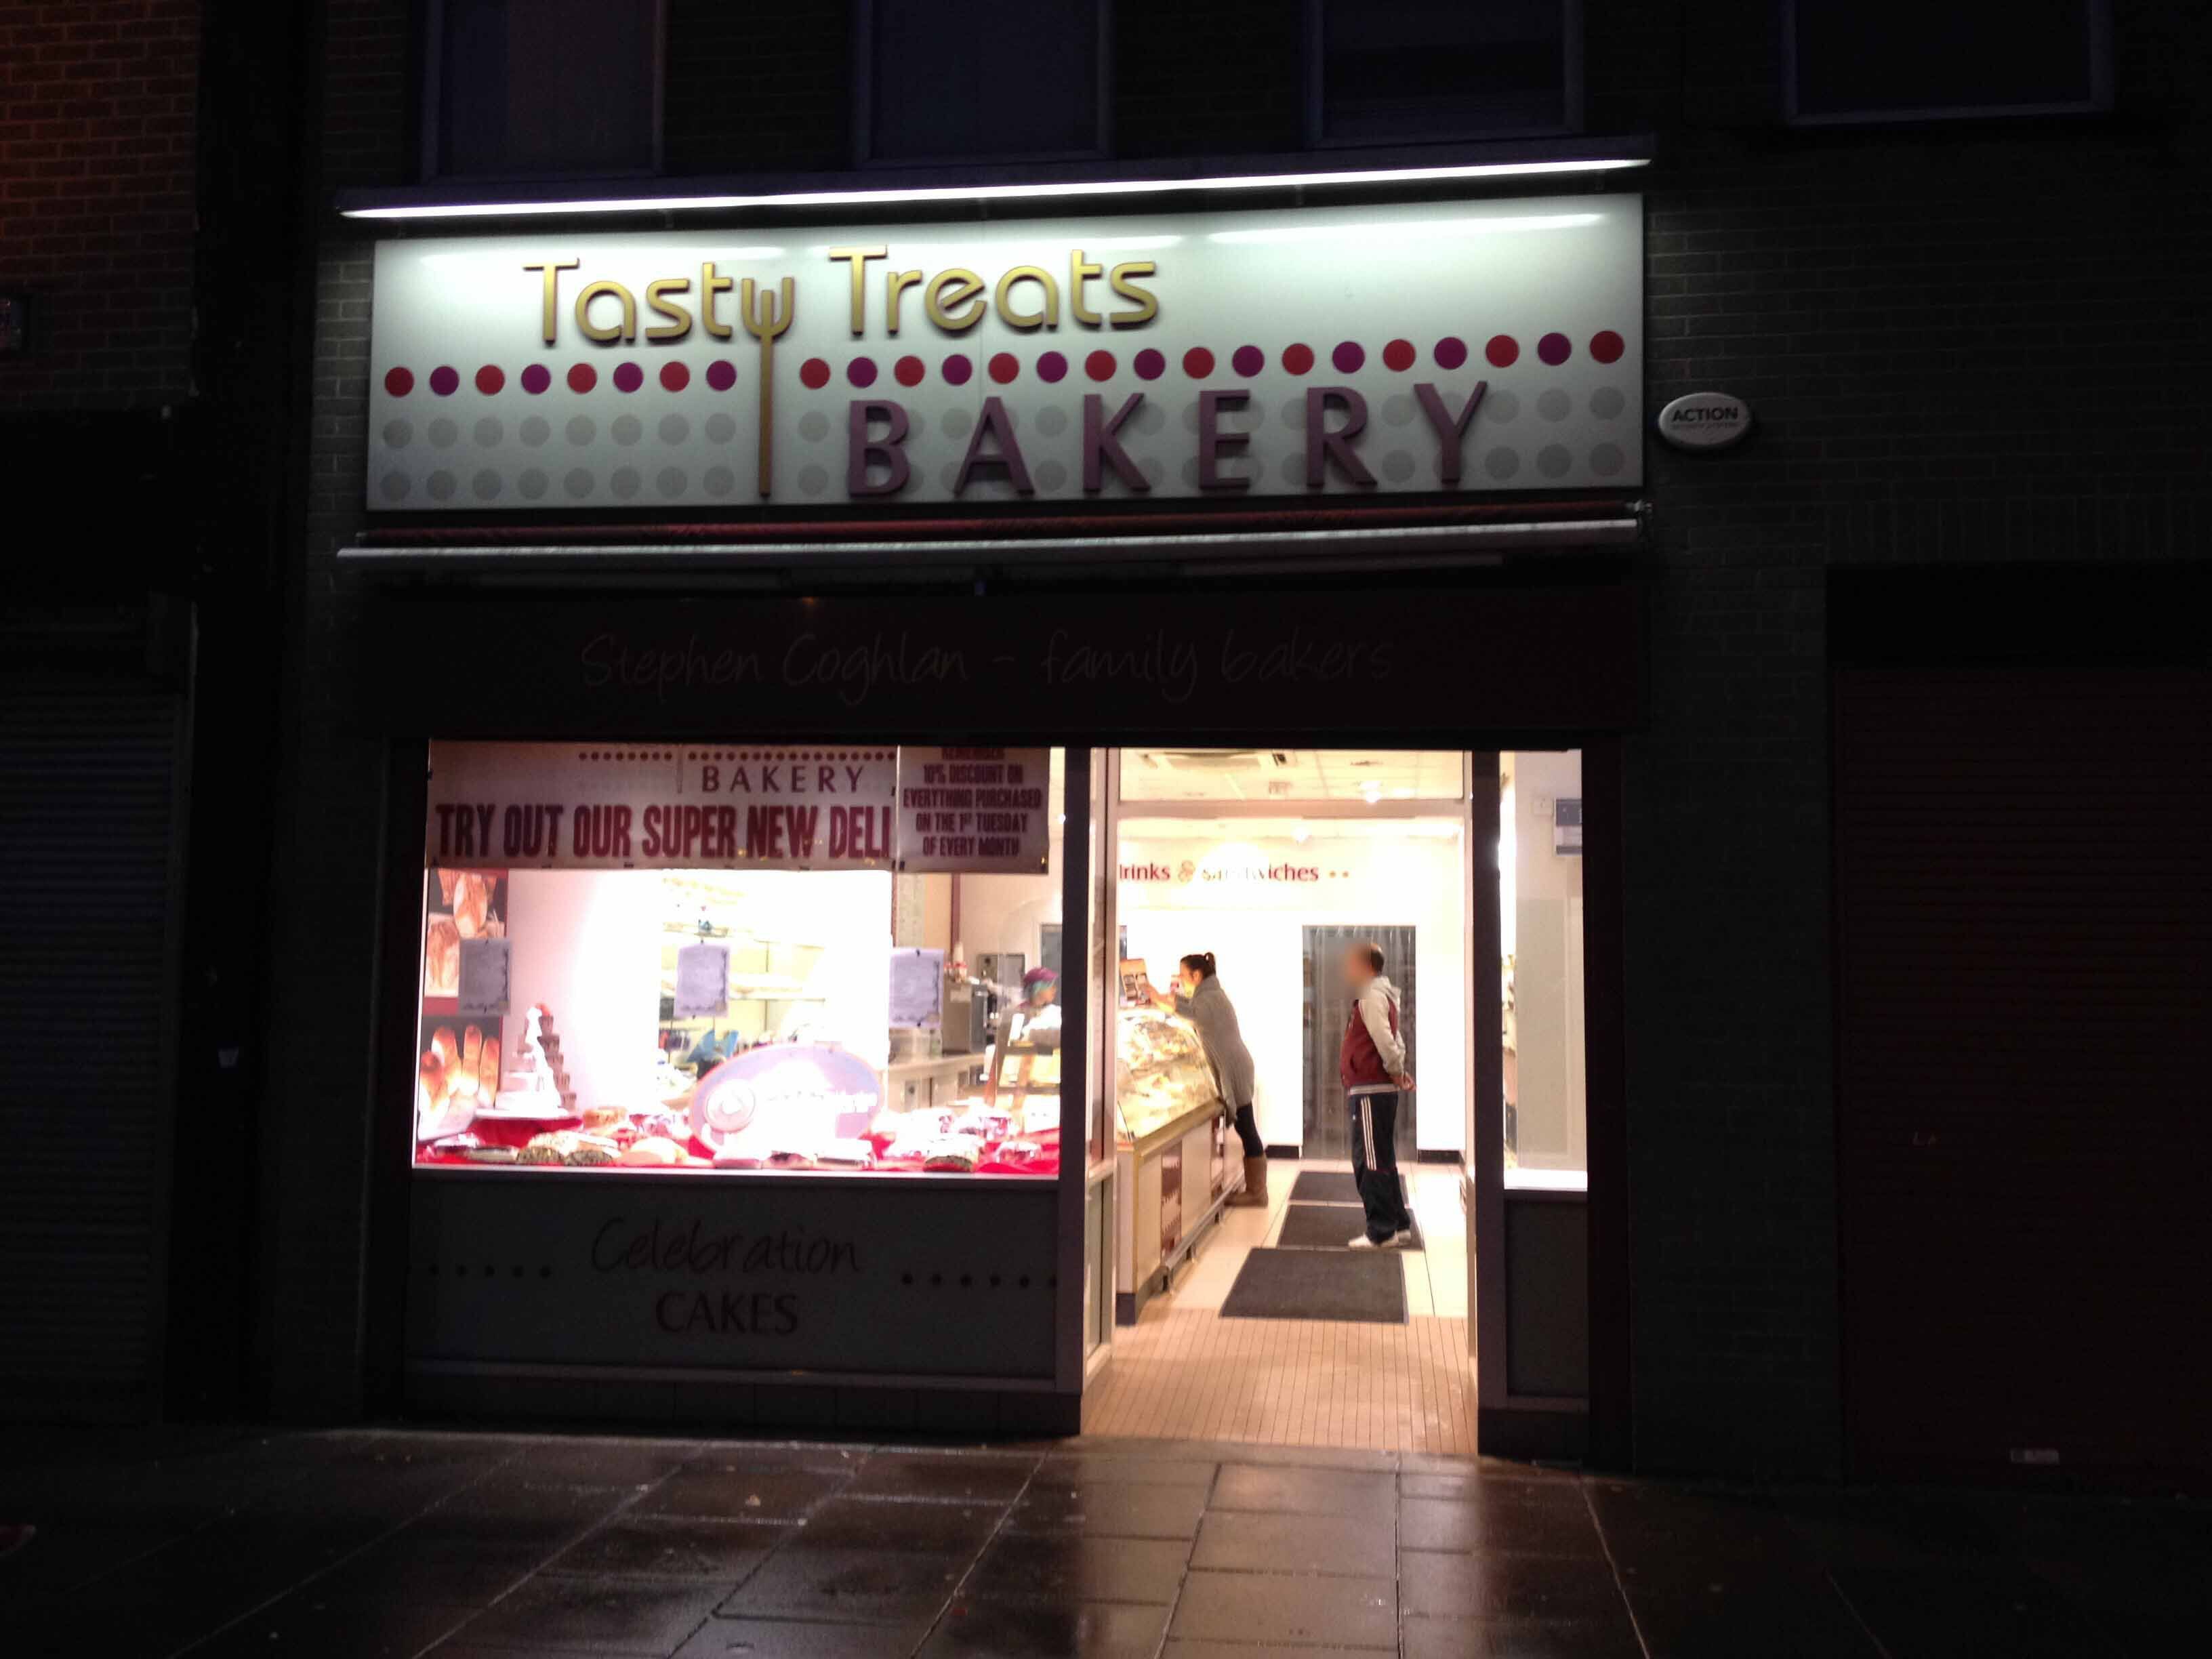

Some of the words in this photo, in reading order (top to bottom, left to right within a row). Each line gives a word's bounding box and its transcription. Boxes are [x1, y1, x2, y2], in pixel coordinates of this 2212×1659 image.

[829, 245, 1159, 336] Treats
[1673, 407, 1738, 422] ACTION
[847, 381, 1488, 497] BAKERY
[581, 632, 765, 705] Stephen
[781, 632, 969, 705] Coghlan
[1040, 628, 1198, 703] family
[1220, 626, 1394, 682] bakers
[701, 765, 863, 793] BAKERY
[949, 764, 1003, 784] DISCOUNT
[903, 787, 972, 808] EVERYTHING
[975, 787, 1042, 808] PURCHASED
[434, 804, 500, 857] TRY
[504, 804, 563, 857] OUT
[573, 805, 632, 858] OUR
[642, 805, 738, 858] SUPER
[745, 805, 818, 857] NEW
[829, 806, 890, 858] DELI
[916, 813, 931, 832] ON
[935, 813, 955, 833] THE
[976, 813, 1028, 833] TUESDAY
[923, 836, 937, 856] OF
[940, 836, 975, 857] EVERY
[978, 836, 1019, 857] MONTH
[1202, 863, 1319, 882] sawiches
[591, 1217, 861, 1274] Celebration
[655, 1291, 800, 1335] CAKES
